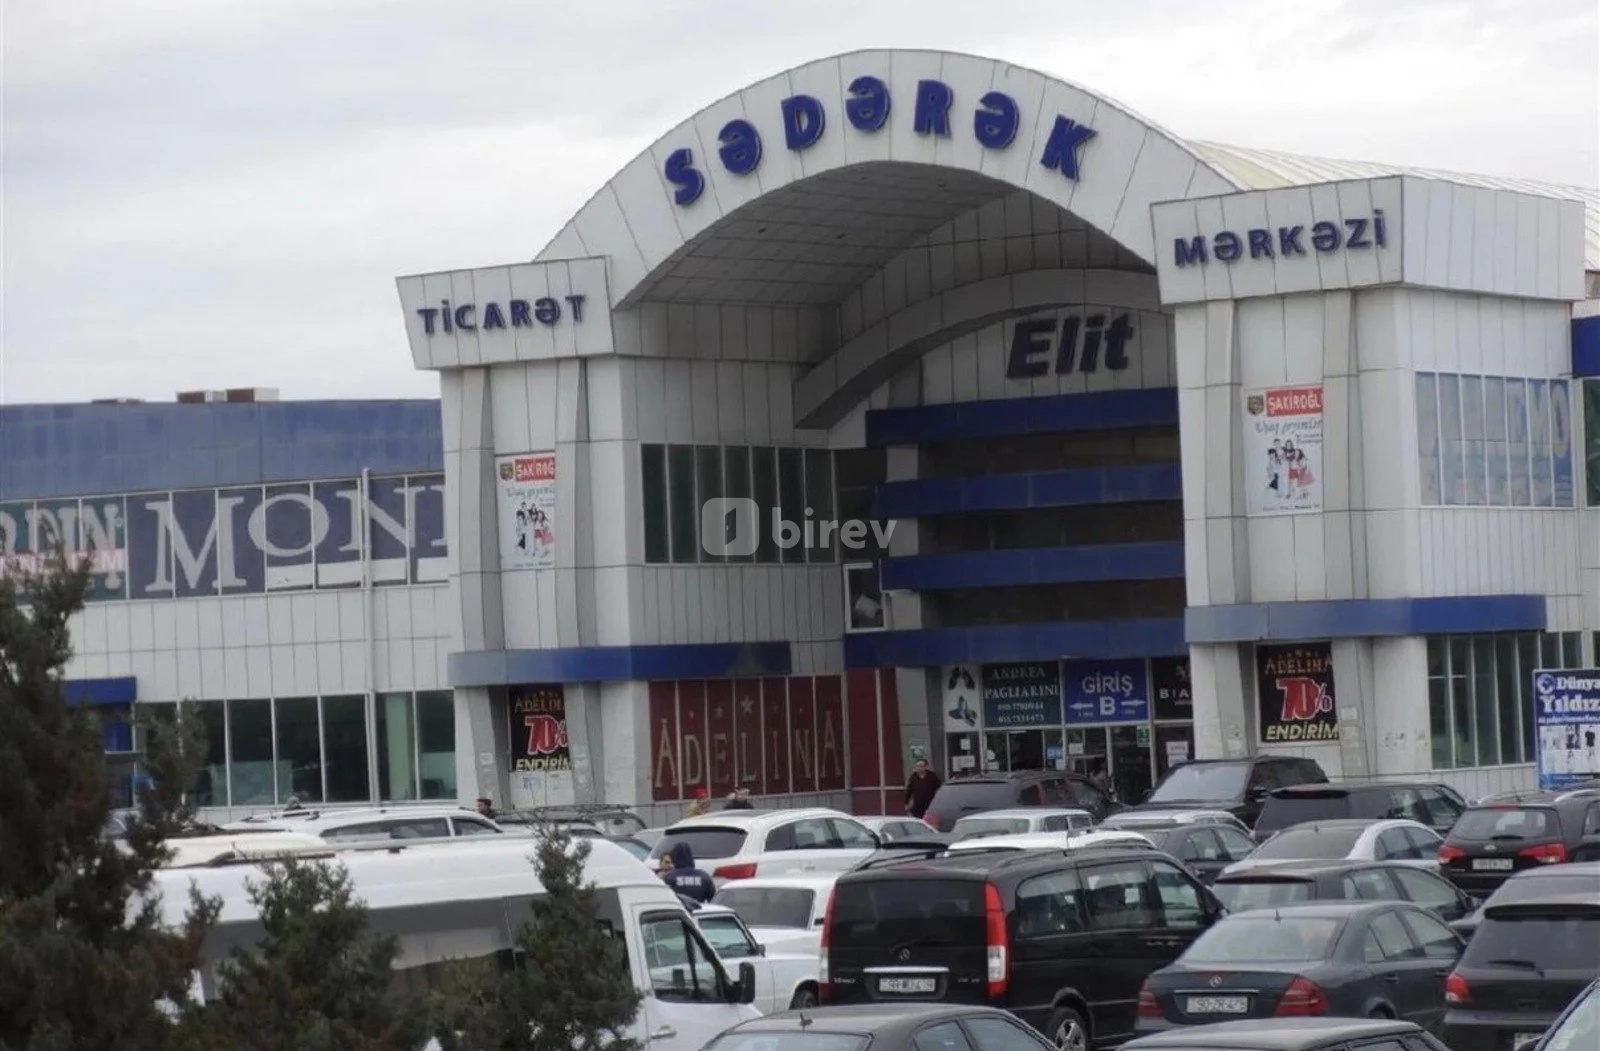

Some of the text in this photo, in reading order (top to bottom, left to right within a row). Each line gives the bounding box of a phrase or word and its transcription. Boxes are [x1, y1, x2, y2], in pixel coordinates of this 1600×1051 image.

[664, 75, 1097, 206] SƏDƏRƏK
[1174, 209, 1387, 268] MƏRKƏZİ
[416, 294, 586, 335] TİCARƏT
[1006, 312, 1134, 379] Elit
[1082, 671, 1133, 697] GİRİŞ
[1099, 696, 1116, 716] B
[655, 711, 844, 788] ADELINA
[1265, 720, 1340, 740] ENDİRİM
